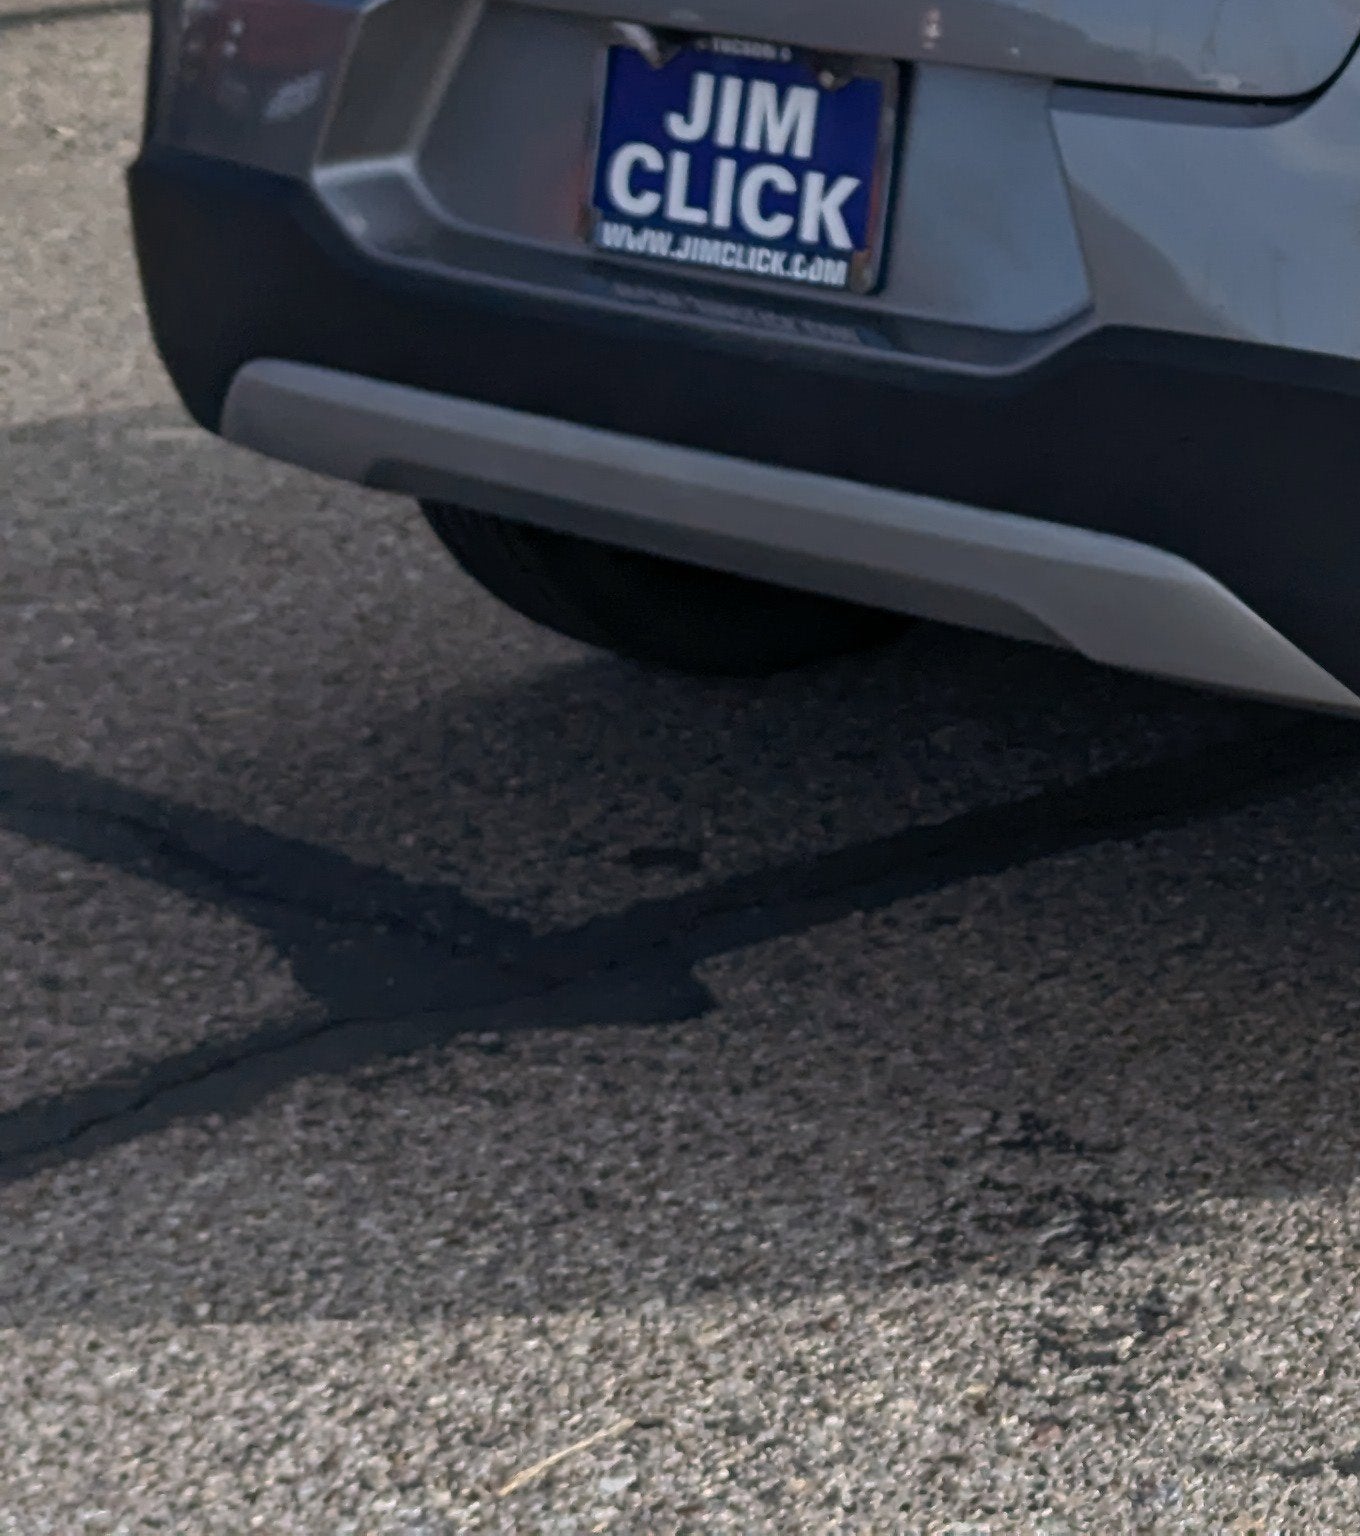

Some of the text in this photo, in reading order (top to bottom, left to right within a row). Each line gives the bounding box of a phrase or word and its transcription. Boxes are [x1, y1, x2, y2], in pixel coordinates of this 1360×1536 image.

[664, 71, 819, 159] JIM
[606, 142, 862, 251] CLICK
[600, 221, 849, 288] WWW.JIMCLICK.COM
